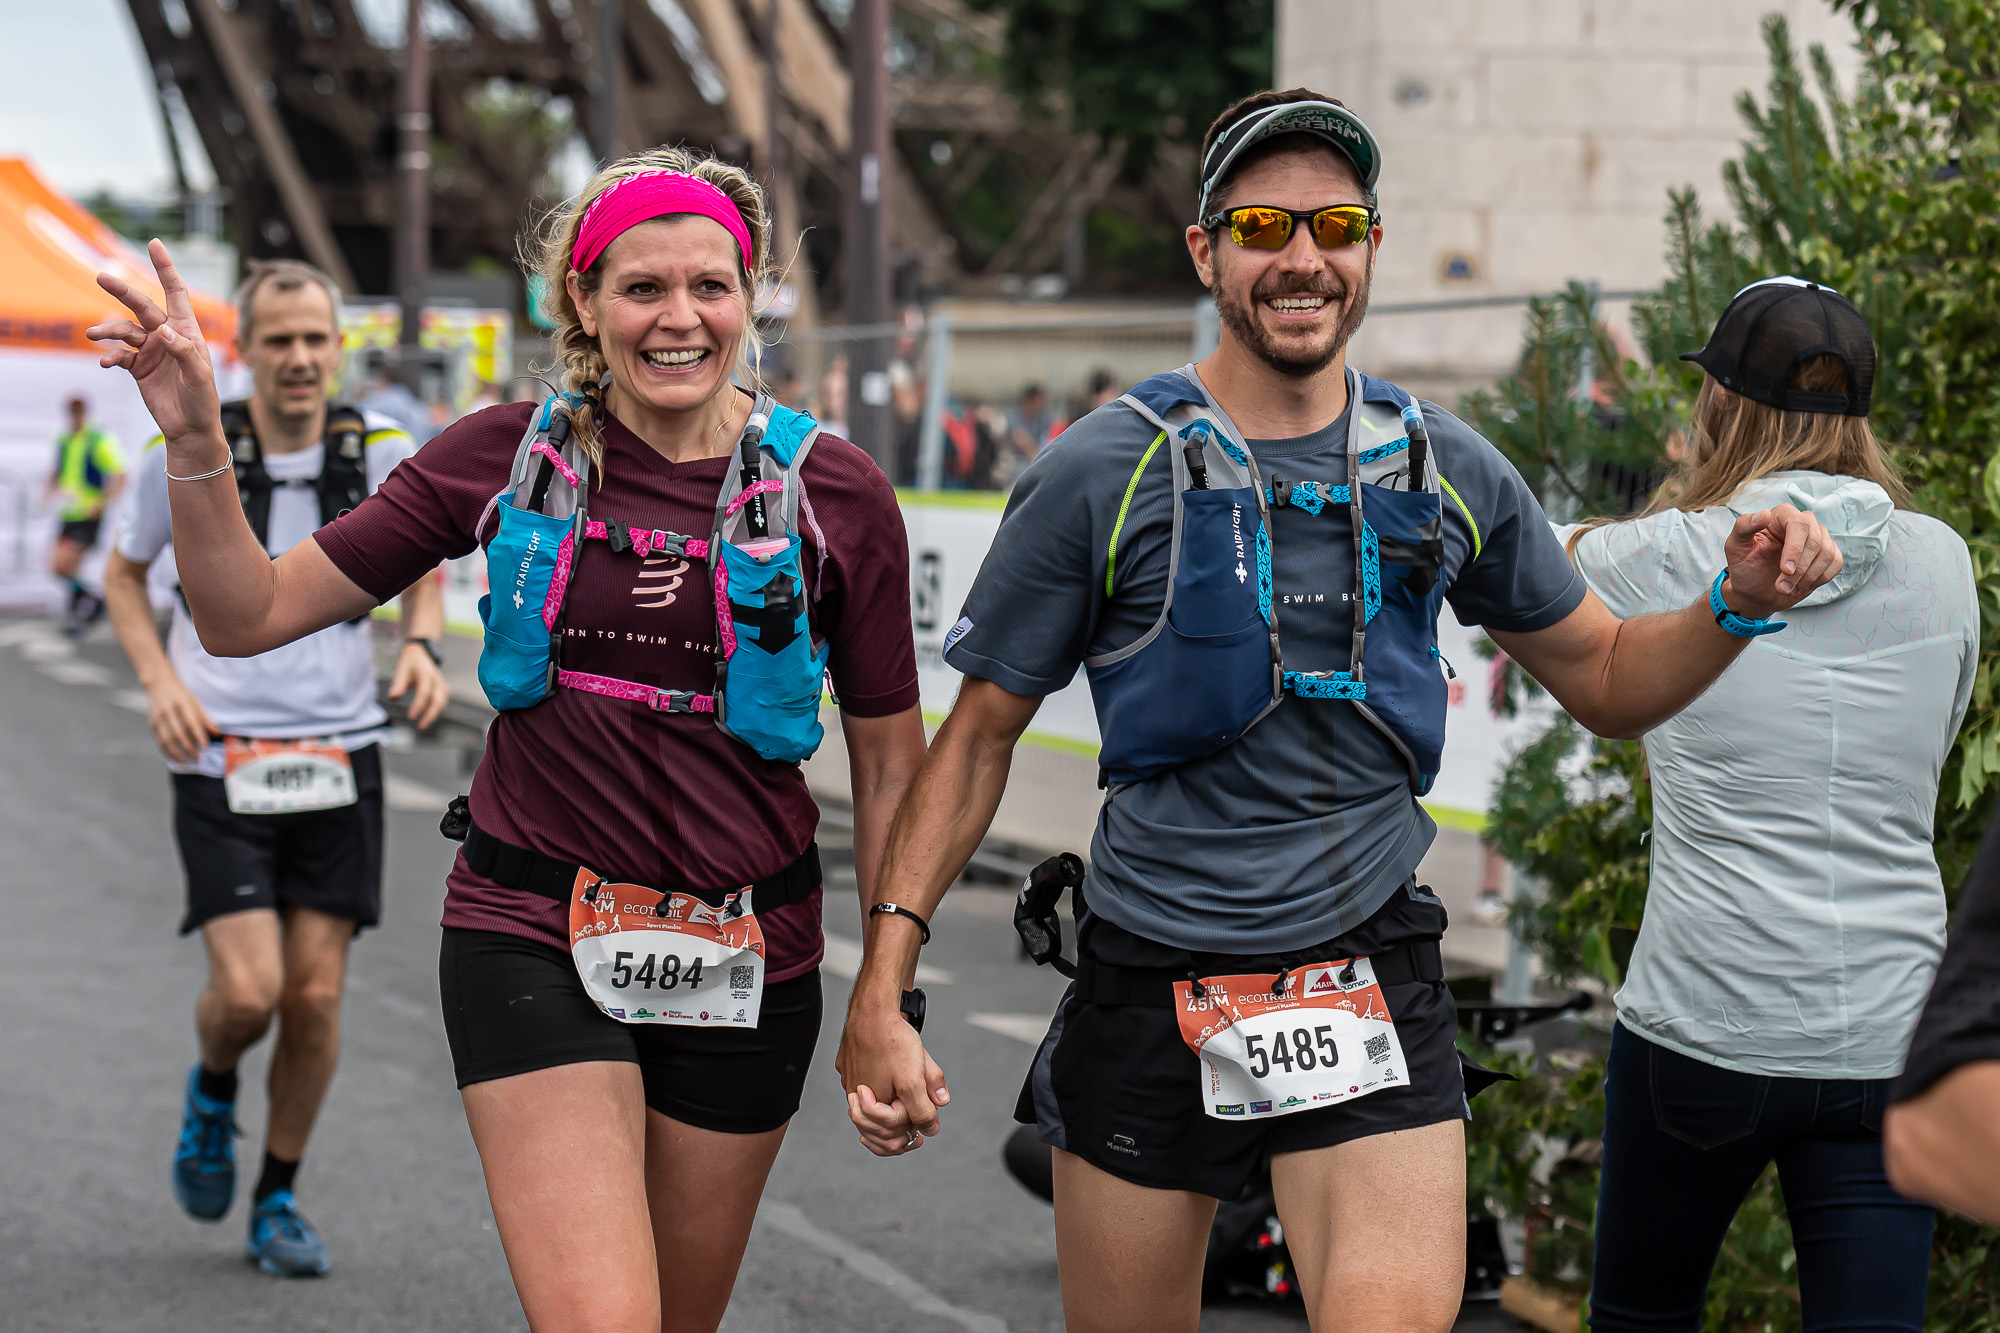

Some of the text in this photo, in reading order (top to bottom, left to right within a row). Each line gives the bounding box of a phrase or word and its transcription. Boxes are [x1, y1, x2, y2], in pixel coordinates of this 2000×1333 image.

[1232, 503, 1245, 559] RAIDLIGHT
[516, 530, 542, 588] RAIDLIGHT
[1283, 594, 1324, 604] SWIM
[597, 630, 616, 640] TO
[626, 632, 668, 645] SWIM
[611, 951, 704, 990] 5484
[1313, 981, 1335, 991] MAIF
[1245, 1025, 1339, 1079] 5485
